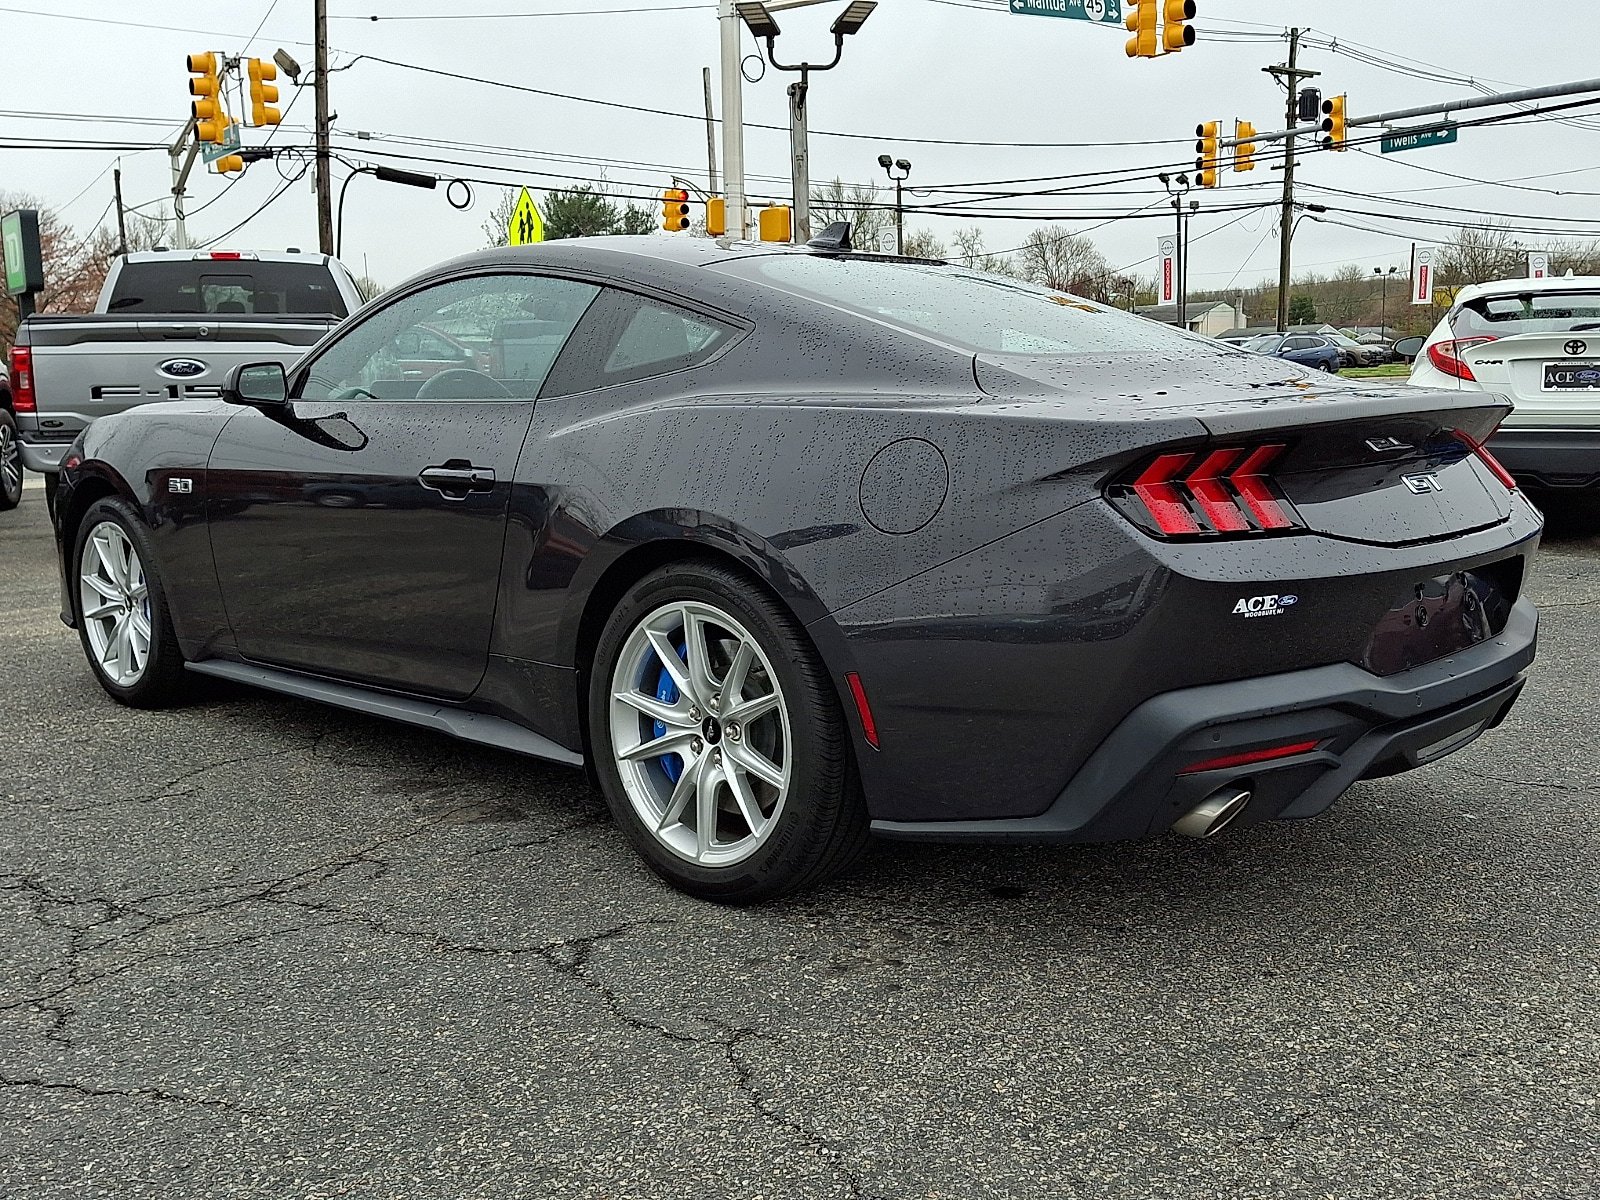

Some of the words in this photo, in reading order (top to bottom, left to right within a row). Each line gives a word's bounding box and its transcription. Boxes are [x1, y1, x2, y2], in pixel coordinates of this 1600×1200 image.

[1027, 0, 1066, 11] Mantua
[1086, 0, 1103, 13] 45
[171, 362, 195, 373] Ford
[1545, 371, 1575, 383] ACE
[90, 384, 222, 401] F-15
[1400, 471, 1443, 495] GT
[1232, 594, 1279, 614] ACE
